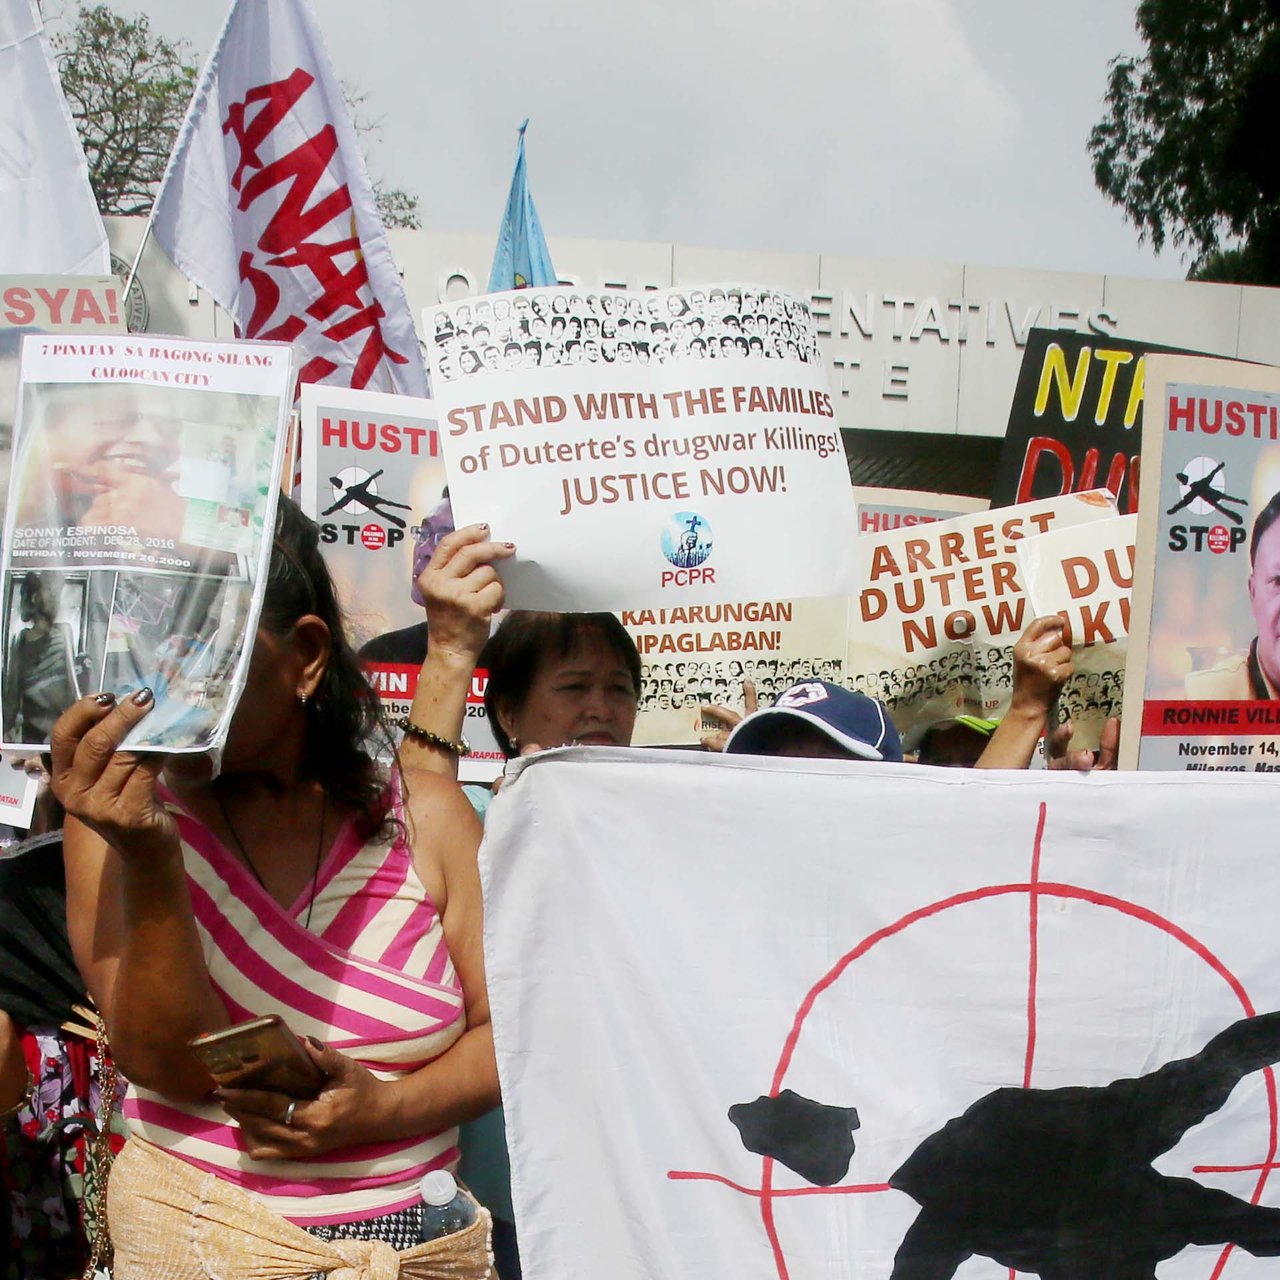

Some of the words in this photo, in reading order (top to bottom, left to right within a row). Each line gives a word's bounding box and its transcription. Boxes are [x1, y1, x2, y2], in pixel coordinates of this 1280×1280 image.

[42, 345, 48, 355] 7
[53, 345, 117, 356] PINATAY
[125, 346, 143, 358] SA
[150, 348, 212, 363] BAGONG
[217, 353, 272, 367] SILANG
[92, 367, 170, 382] CALOOCAN
[175, 373, 212, 386] CITY
[447, 395, 567, 437] STAND
[573, 392, 659, 421] WITH
[663, 387, 725, 418] THE
[732, 386, 834, 419] FAMILIES
[322, 418, 437, 456] HUSTI
[460, 445, 491, 474] of
[644, 431, 757, 460] drugwar
[764, 427, 840, 458] Killings!
[560, 471, 690, 515] JUSTICE
[699, 465, 788, 496] NOW!
[13, 539, 36, 548] DATE
[38, 538, 52, 547] OF
[146, 538, 174, 549] 2016
[15, 528, 64, 539] SONNY
[67, 526, 137, 537] ESPINOSA
[13, 550, 64, 558] BIRTHDAY
[74, 551, 136, 560] NOVEMBER
[661, 567, 716, 588] PCPR
[859, 561, 1023, 622] DUTER
[622, 602, 792, 626] KATARUNGAN
[902, 597, 1026, 653] NOW
[637, 631, 781, 654] IPAGLABAN!
[1163, 708, 1239, 725] RONNIE
[1178, 743, 1254, 756] November
[1259, 742, 1279, 757] 14,
